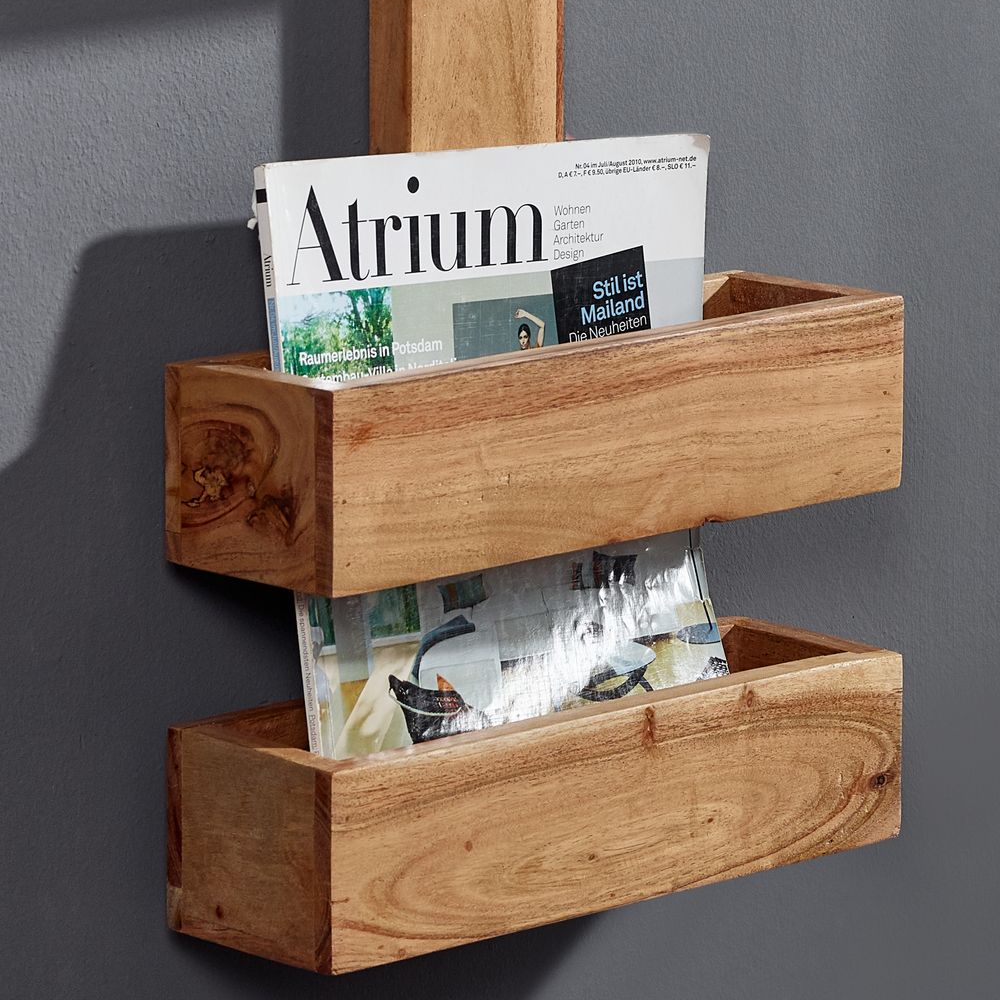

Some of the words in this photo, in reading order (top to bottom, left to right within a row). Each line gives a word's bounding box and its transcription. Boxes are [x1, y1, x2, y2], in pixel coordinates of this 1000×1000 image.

[598, 159, 628, 168] Juli/August
[644, 155, 696, 164] www.atrium-net.de
[605, 167, 622, 175] übrige
[623, 165, 651, 173] EU-Länder
[554, 204, 591, 216] Wohnen
[286, 176, 548, 286] Atrium
[554, 220, 584, 231] Garten
[553, 233, 604, 245] Architektur
[554, 248, 584, 261] Design
[263, 253, 273, 288] Atrium
[593, 276, 621, 300] Stil
[623, 270, 644, 292] ist
[581, 290, 645, 326] Mailand
[569, 331, 587, 343] Die
[589, 315, 647, 340] Neuheiten
[300, 344, 377, 366] Raumerlebnis
[379, 344, 389, 357] in
[392, 338, 442, 355] Potsdam
